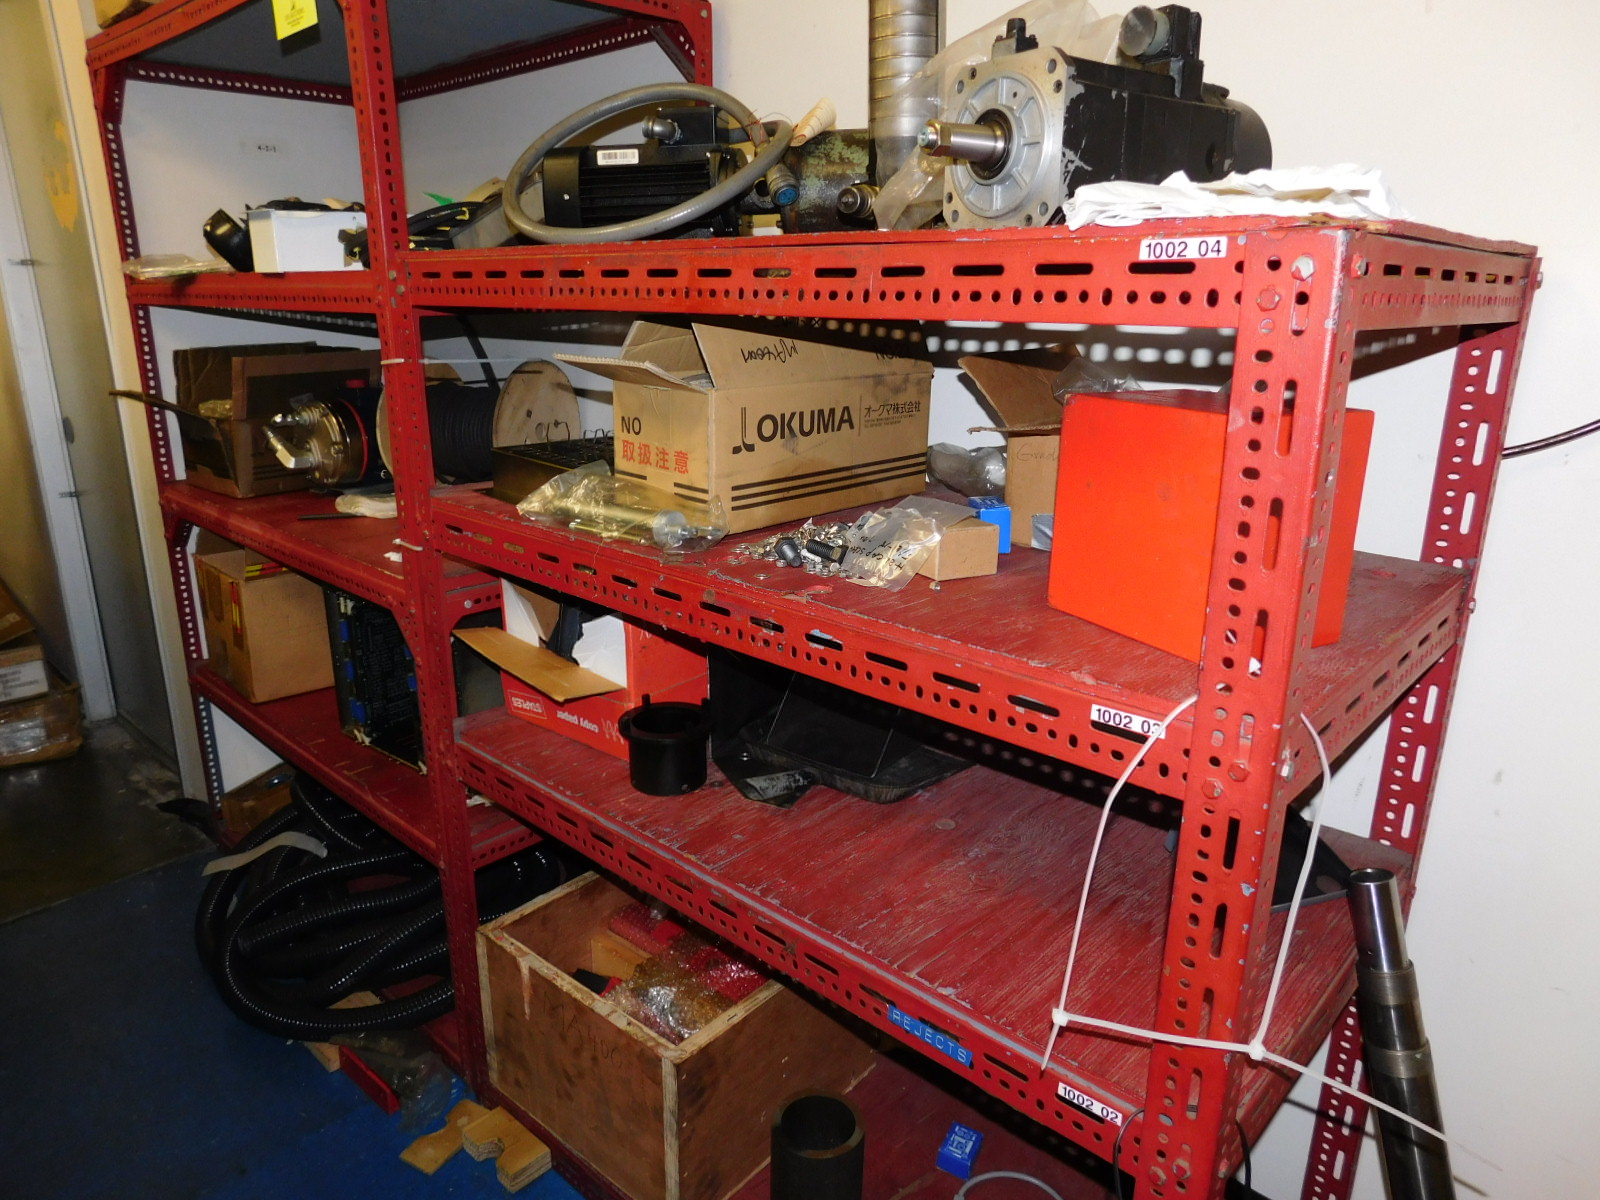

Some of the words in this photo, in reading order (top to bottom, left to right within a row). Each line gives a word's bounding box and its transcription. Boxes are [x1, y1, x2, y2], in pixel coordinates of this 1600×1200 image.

[1145, 241, 1188, 259] 1002
[1198, 240, 1222, 257] 04
[864, 400, 921, 418] オークマ株式会社
[621, 416, 642, 435] NO
[756, 405, 855, 443] OKUMA
[622, 440, 689, 474] 取扱注意
[511, 696, 543, 713] STAPLES
[556, 709, 580, 726] paper
[579, 717, 600, 734] copy
[1095, 707, 1133, 729] 1002
[892, 1008, 967, 1063] REJECTS
[1062, 1086, 1094, 1111] 1002
[1101, 1106, 1119, 1124] 02
